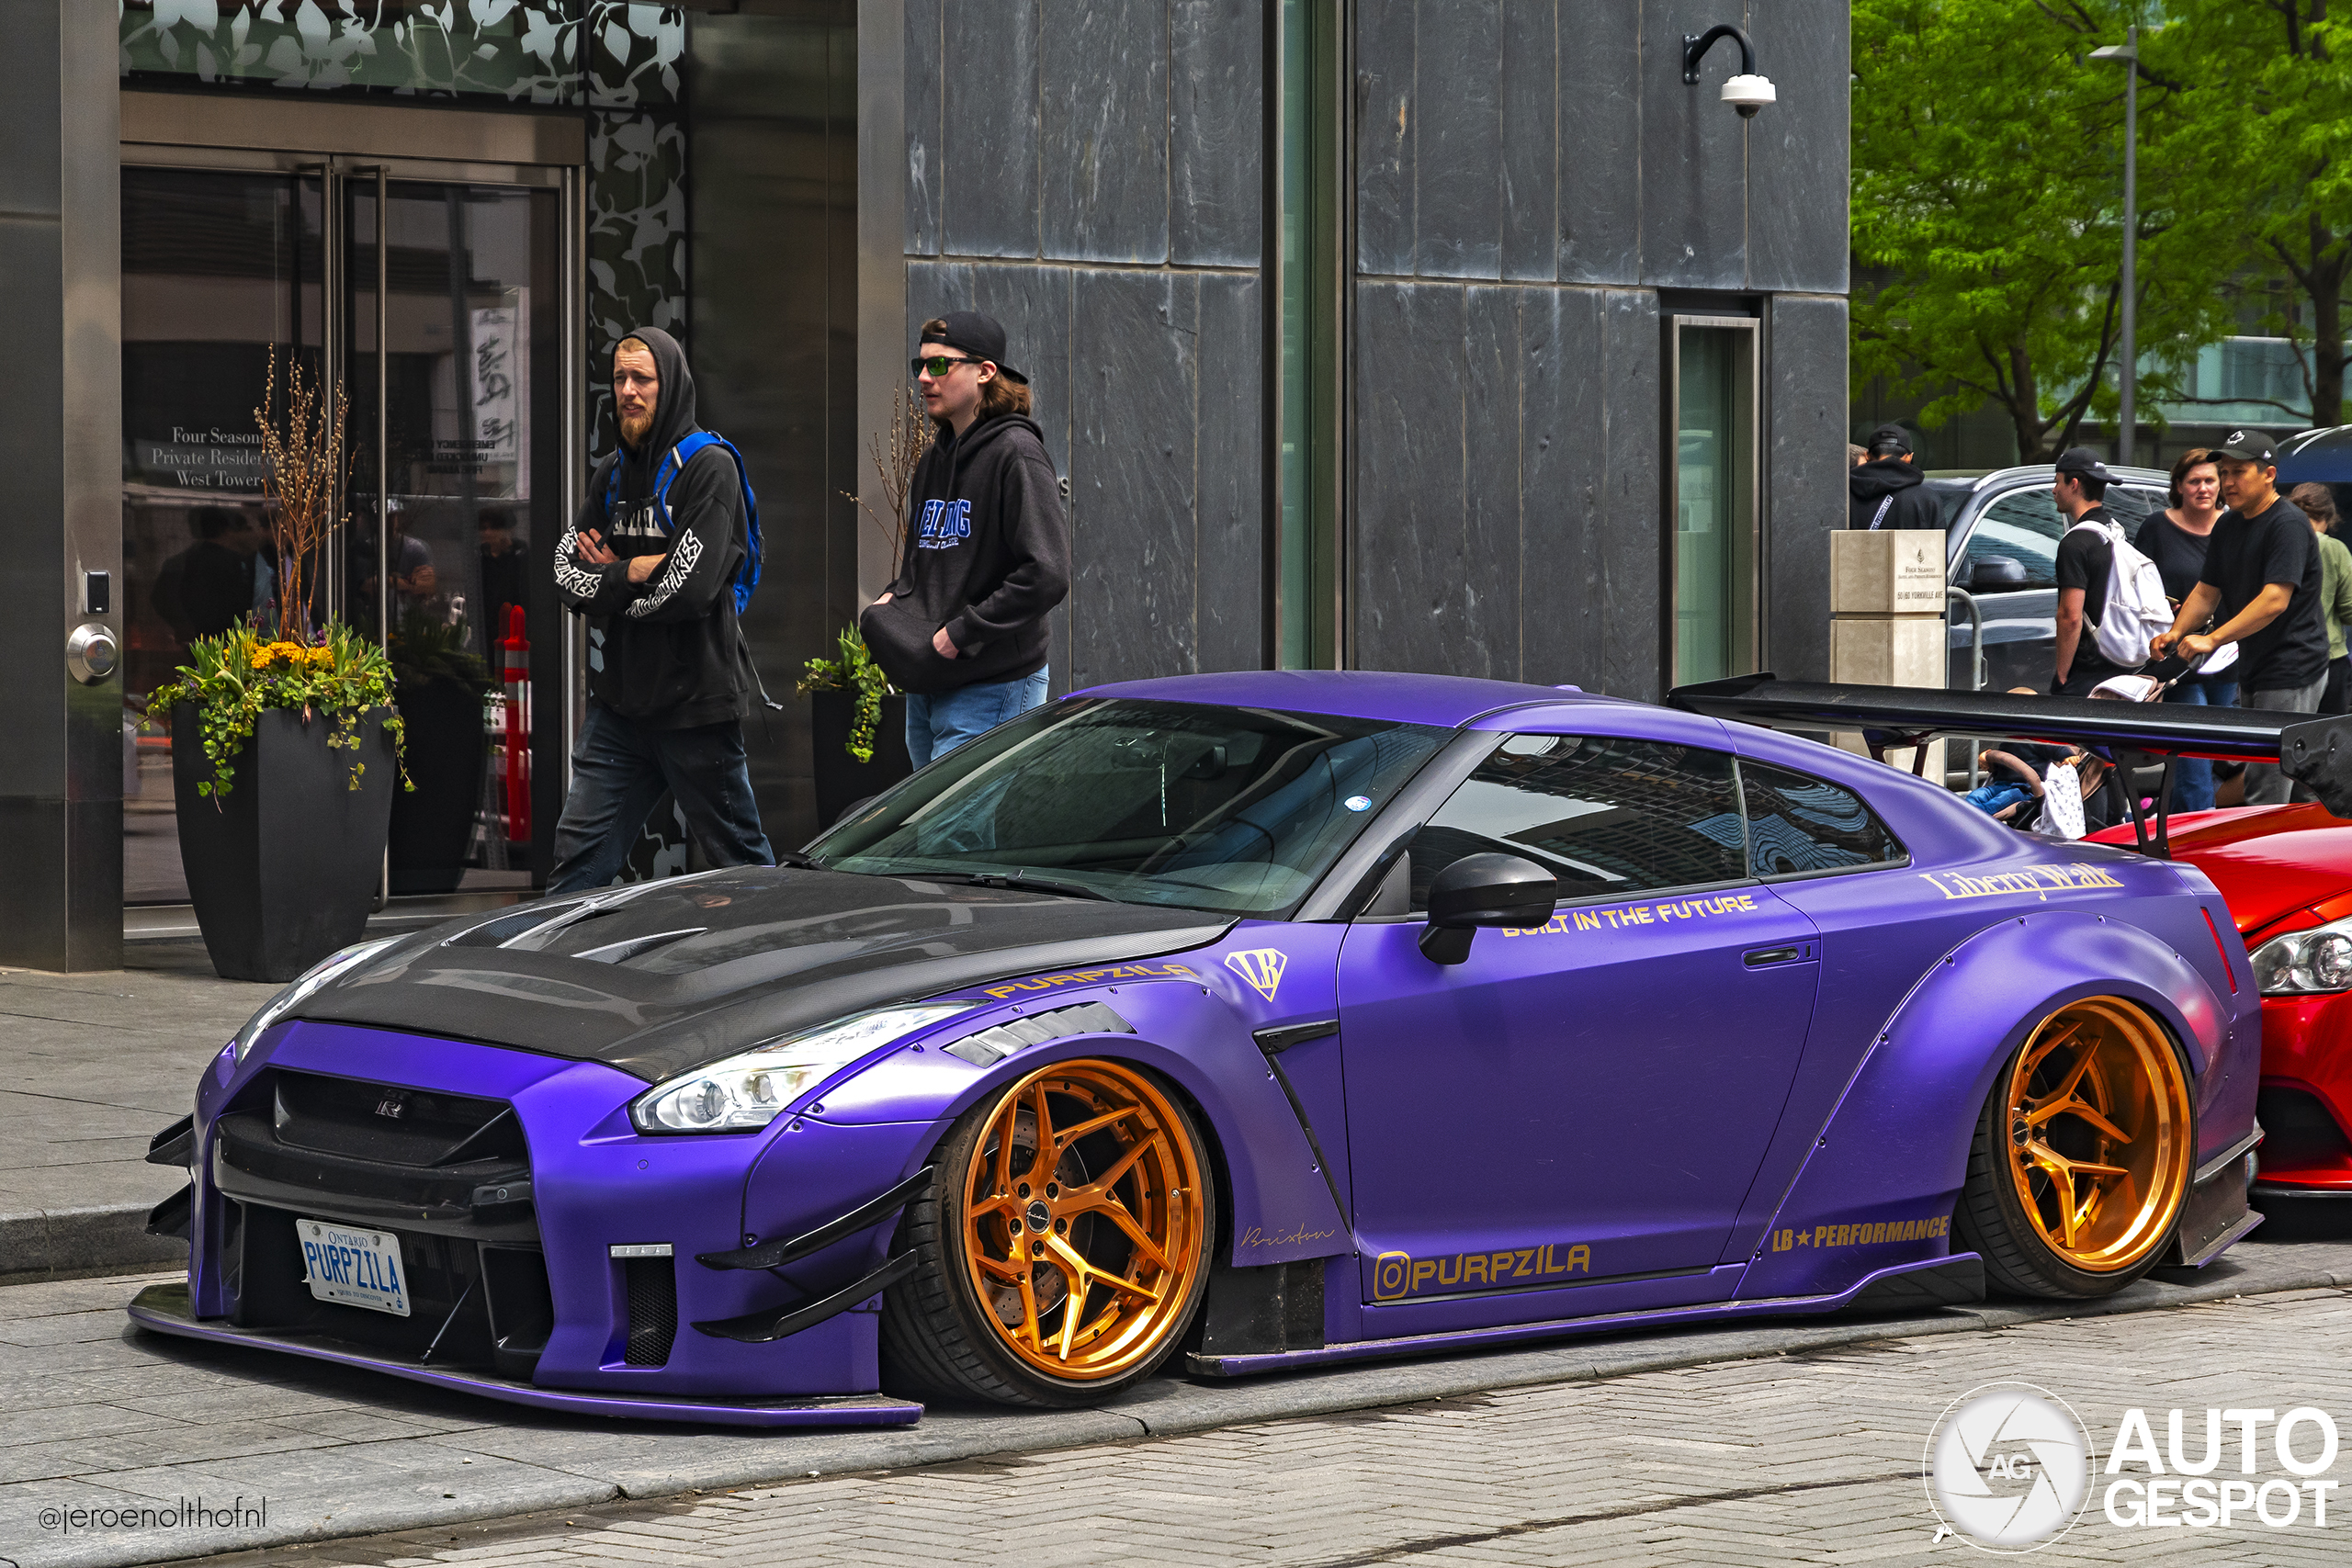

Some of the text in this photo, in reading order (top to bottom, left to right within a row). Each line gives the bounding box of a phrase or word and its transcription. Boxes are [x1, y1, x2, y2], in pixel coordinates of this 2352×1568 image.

[172, 426, 207, 444] Four
[152, 447, 205, 465] Private
[176, 469, 260, 486] West Tower
[1919, 862, 2125, 902] Liberty Walk
[1572, 910, 1602, 931] IN
[1600, 906, 1655, 930] THE
[1657, 894, 1758, 923] FUTURE
[983, 964, 1202, 999] PURPZILA
[328, 1231, 368, 1248] ONTARIO
[1239, 1222, 1336, 1248] Brixton
[1772, 1215, 1950, 1253] LB PERFORMANCE
[304, 1241, 401, 1295] PURPZILA
[1411, 1244, 1591, 1292] PURPZILA
[360, 1292, 382, 1303] DISCOVER
